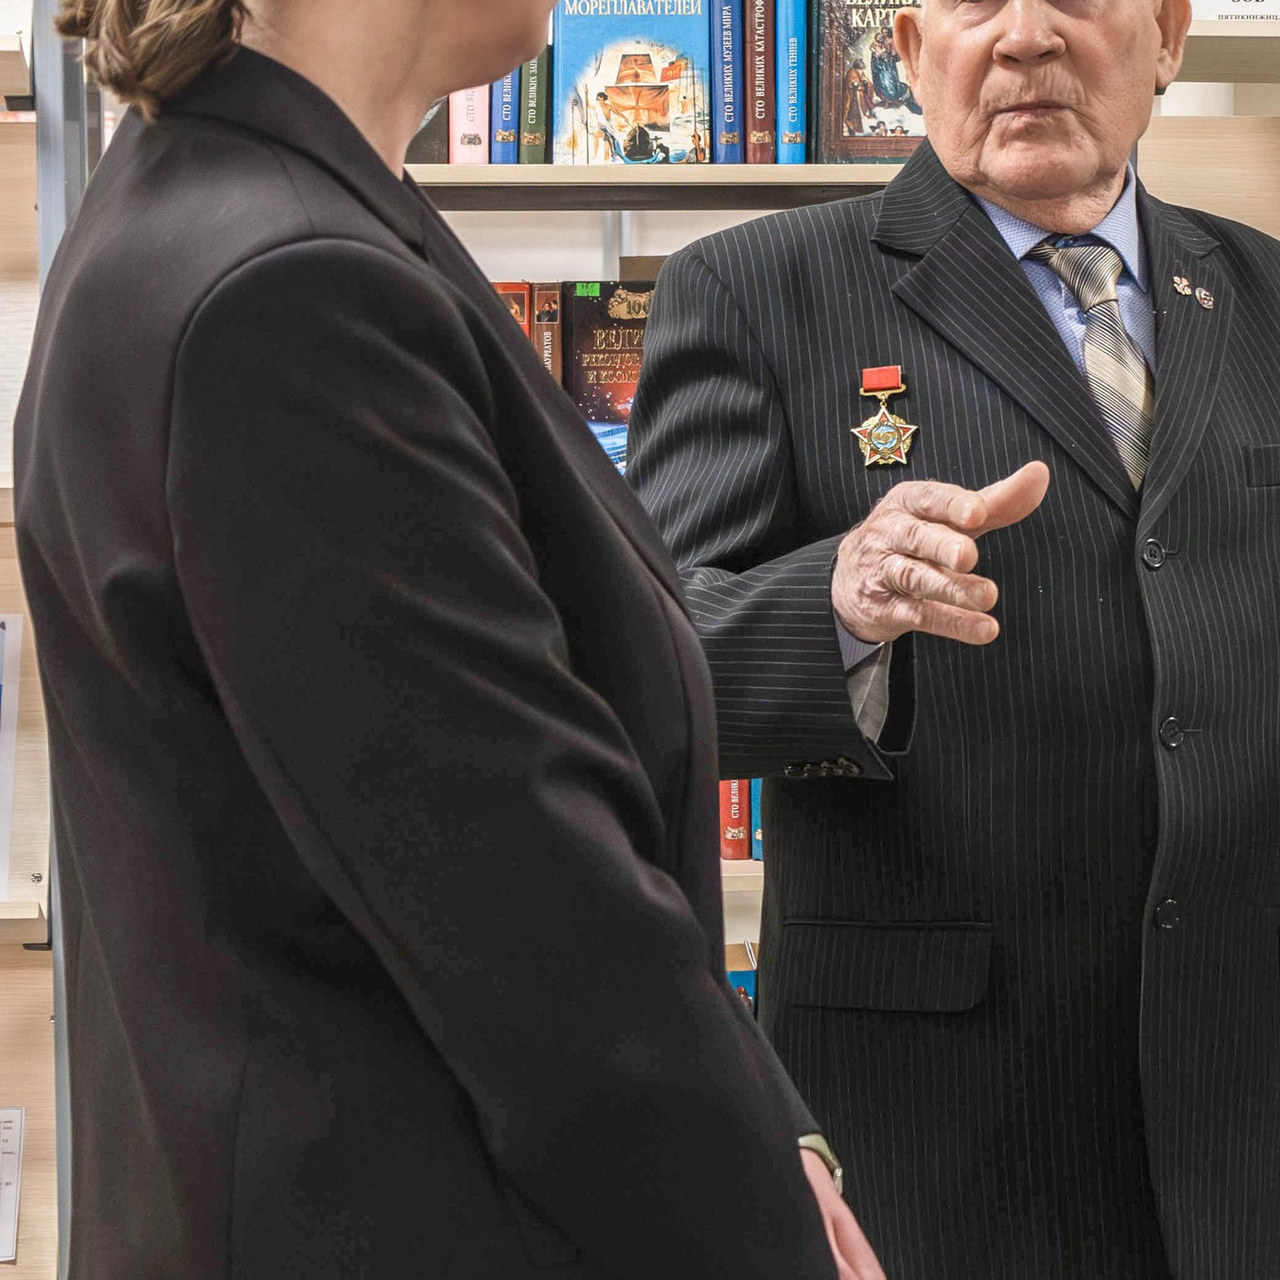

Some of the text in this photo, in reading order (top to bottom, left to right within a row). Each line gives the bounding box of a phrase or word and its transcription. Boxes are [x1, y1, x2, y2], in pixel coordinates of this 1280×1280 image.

[851, 8, 898, 28] КАРТ
[722, 5, 734, 122] СТО ВЕЛИКИХ МУЗЕЕВ МИРА
[755, 55, 765, 97] ВЕЛИКИХ
[788, 37, 798, 122] СТО ВЕЛИКИХ ГЕНИЕВ
[502, 73, 512, 121] СТО ВЕЛИК
[528, 76, 538, 108] ВЕЛИКИХ
[528, 109, 536, 124] СТО
[756, 100, 765, 119] СТО
[626, 300, 650, 315] 100
[593, 328, 644, 350] ВЕЛИ
[599, 370, 639, 384] КОСМО
[731, 804, 739, 819] СТО
